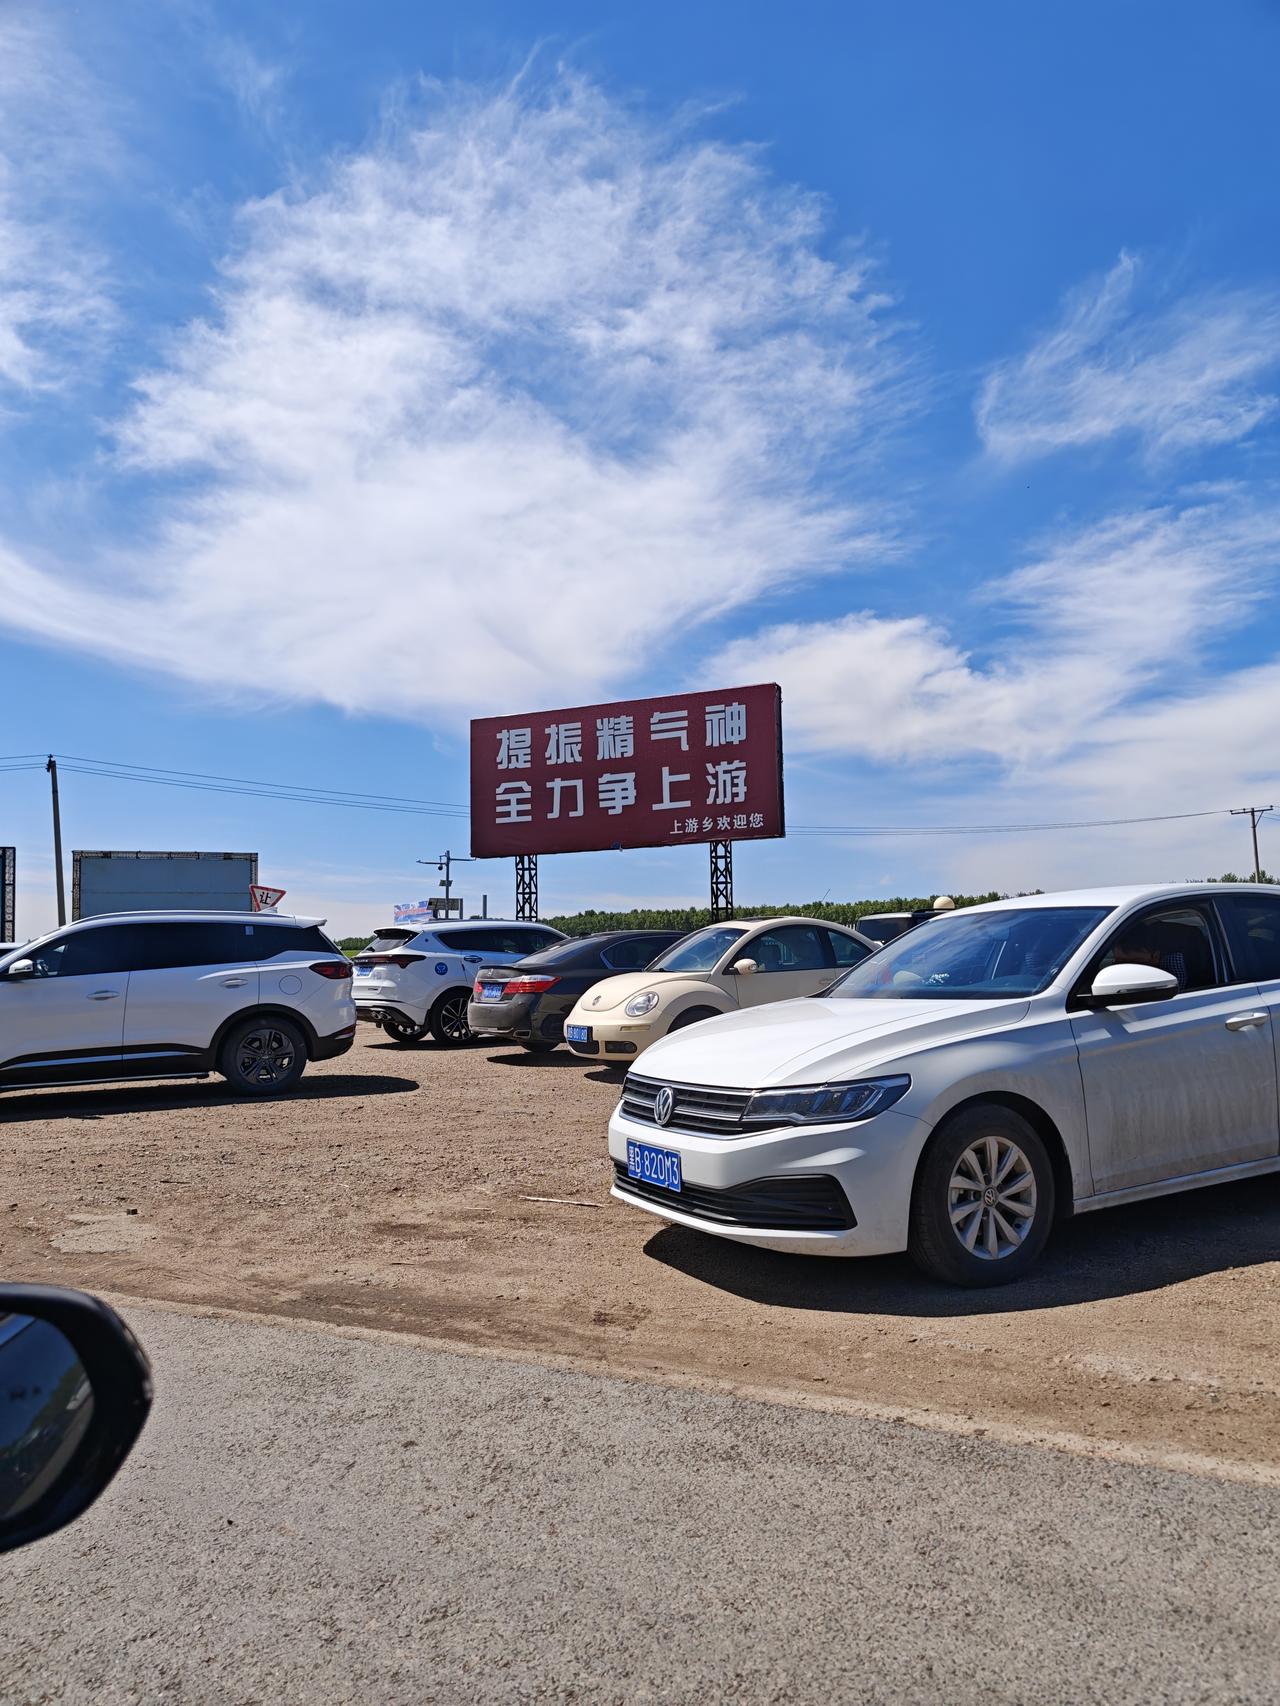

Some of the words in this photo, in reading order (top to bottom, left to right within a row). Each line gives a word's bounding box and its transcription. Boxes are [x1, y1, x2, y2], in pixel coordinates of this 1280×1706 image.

[495, 702, 747, 769] 提振精气神
[495, 759, 747, 823] 全力争上游
[670, 813, 764, 834] 上游乡欢迎您
[259, 891, 271, 905] 让
